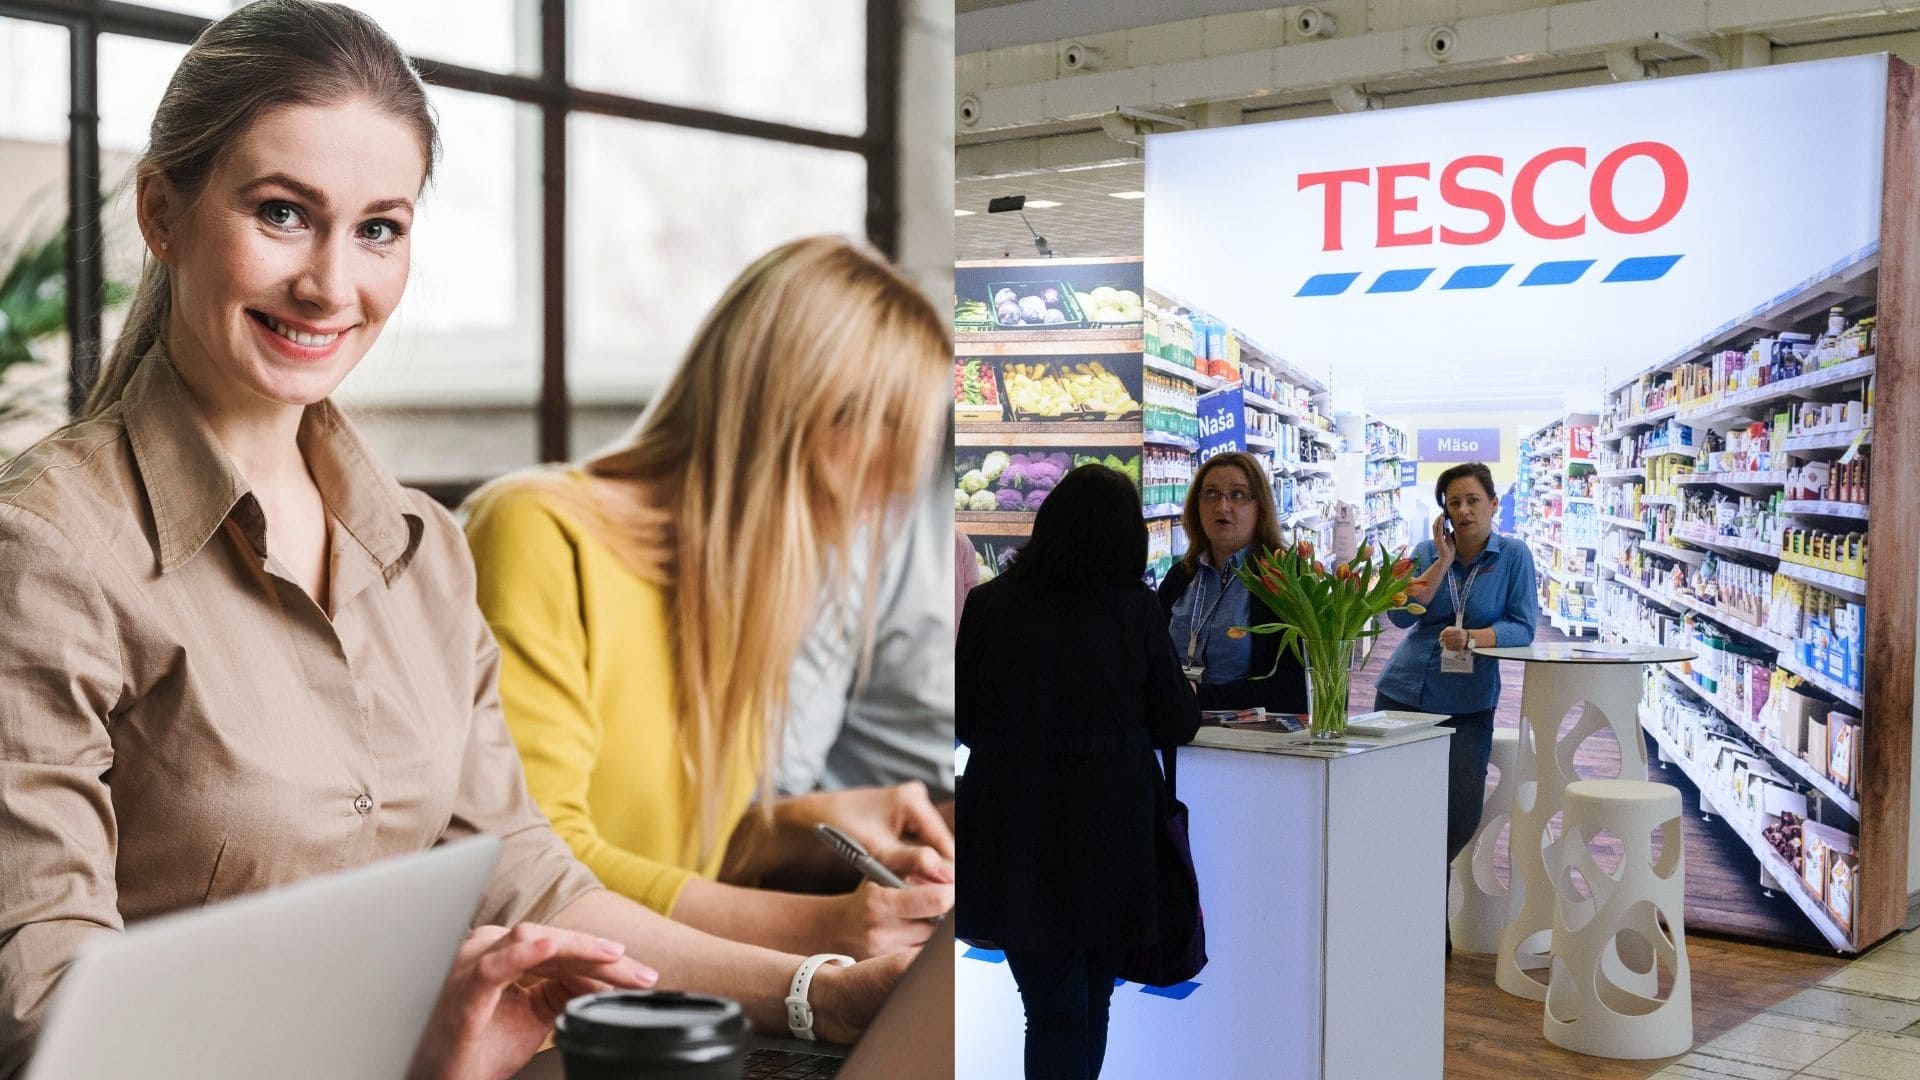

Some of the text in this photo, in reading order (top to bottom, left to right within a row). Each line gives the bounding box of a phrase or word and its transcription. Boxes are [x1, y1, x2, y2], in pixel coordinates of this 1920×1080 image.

[1297, 141, 1689, 252] TESCO
[1198, 407, 1235, 438] Naša
[1437, 437, 1479, 452] Mäso
